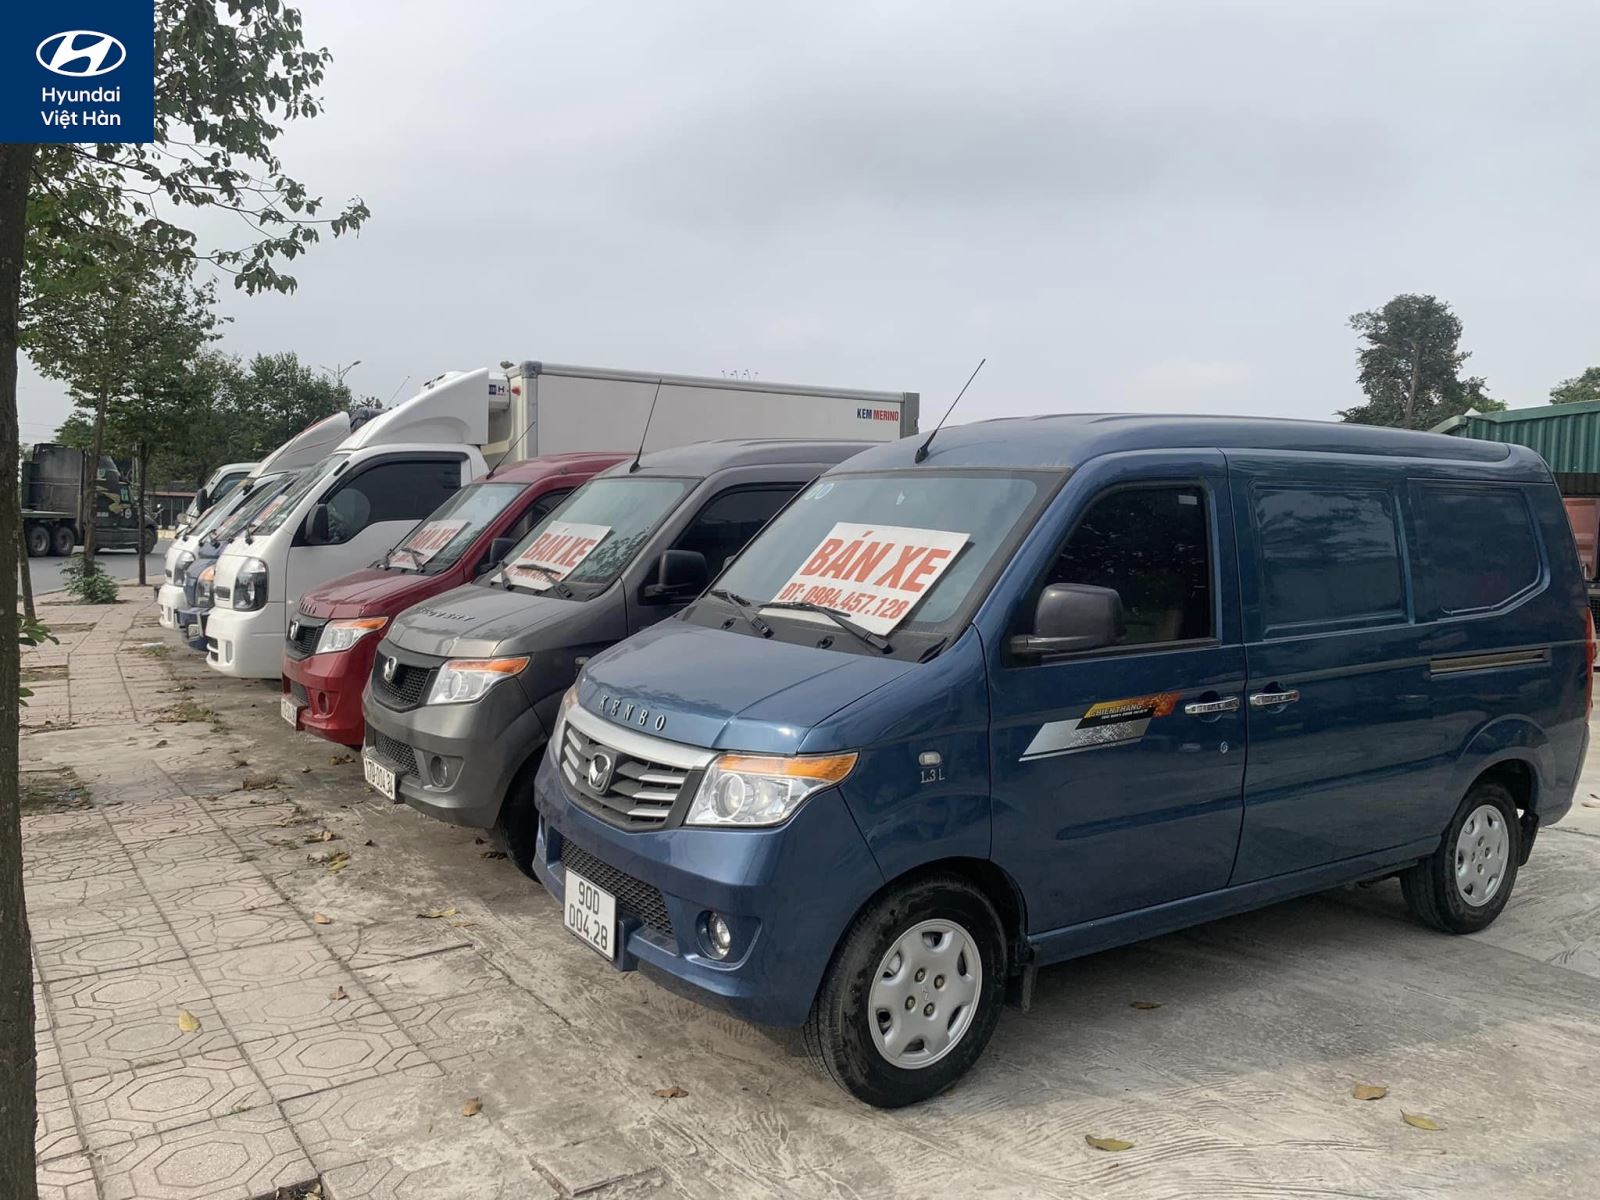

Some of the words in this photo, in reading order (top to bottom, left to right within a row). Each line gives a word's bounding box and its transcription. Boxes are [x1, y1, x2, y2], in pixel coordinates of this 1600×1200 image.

[856, 408, 873, 420] KEM
[873, 409, 899, 422] MERINO
[553, 536, 598, 568] XE
[800, 530, 896, 583] BÁN
[873, 545, 952, 593] XE
[801, 585, 910, 620] 0984.457.128
[599, 694, 667, 731] KENBO
[578, 880, 600, 916] 90D
[568, 903, 608, 951] 004.28
